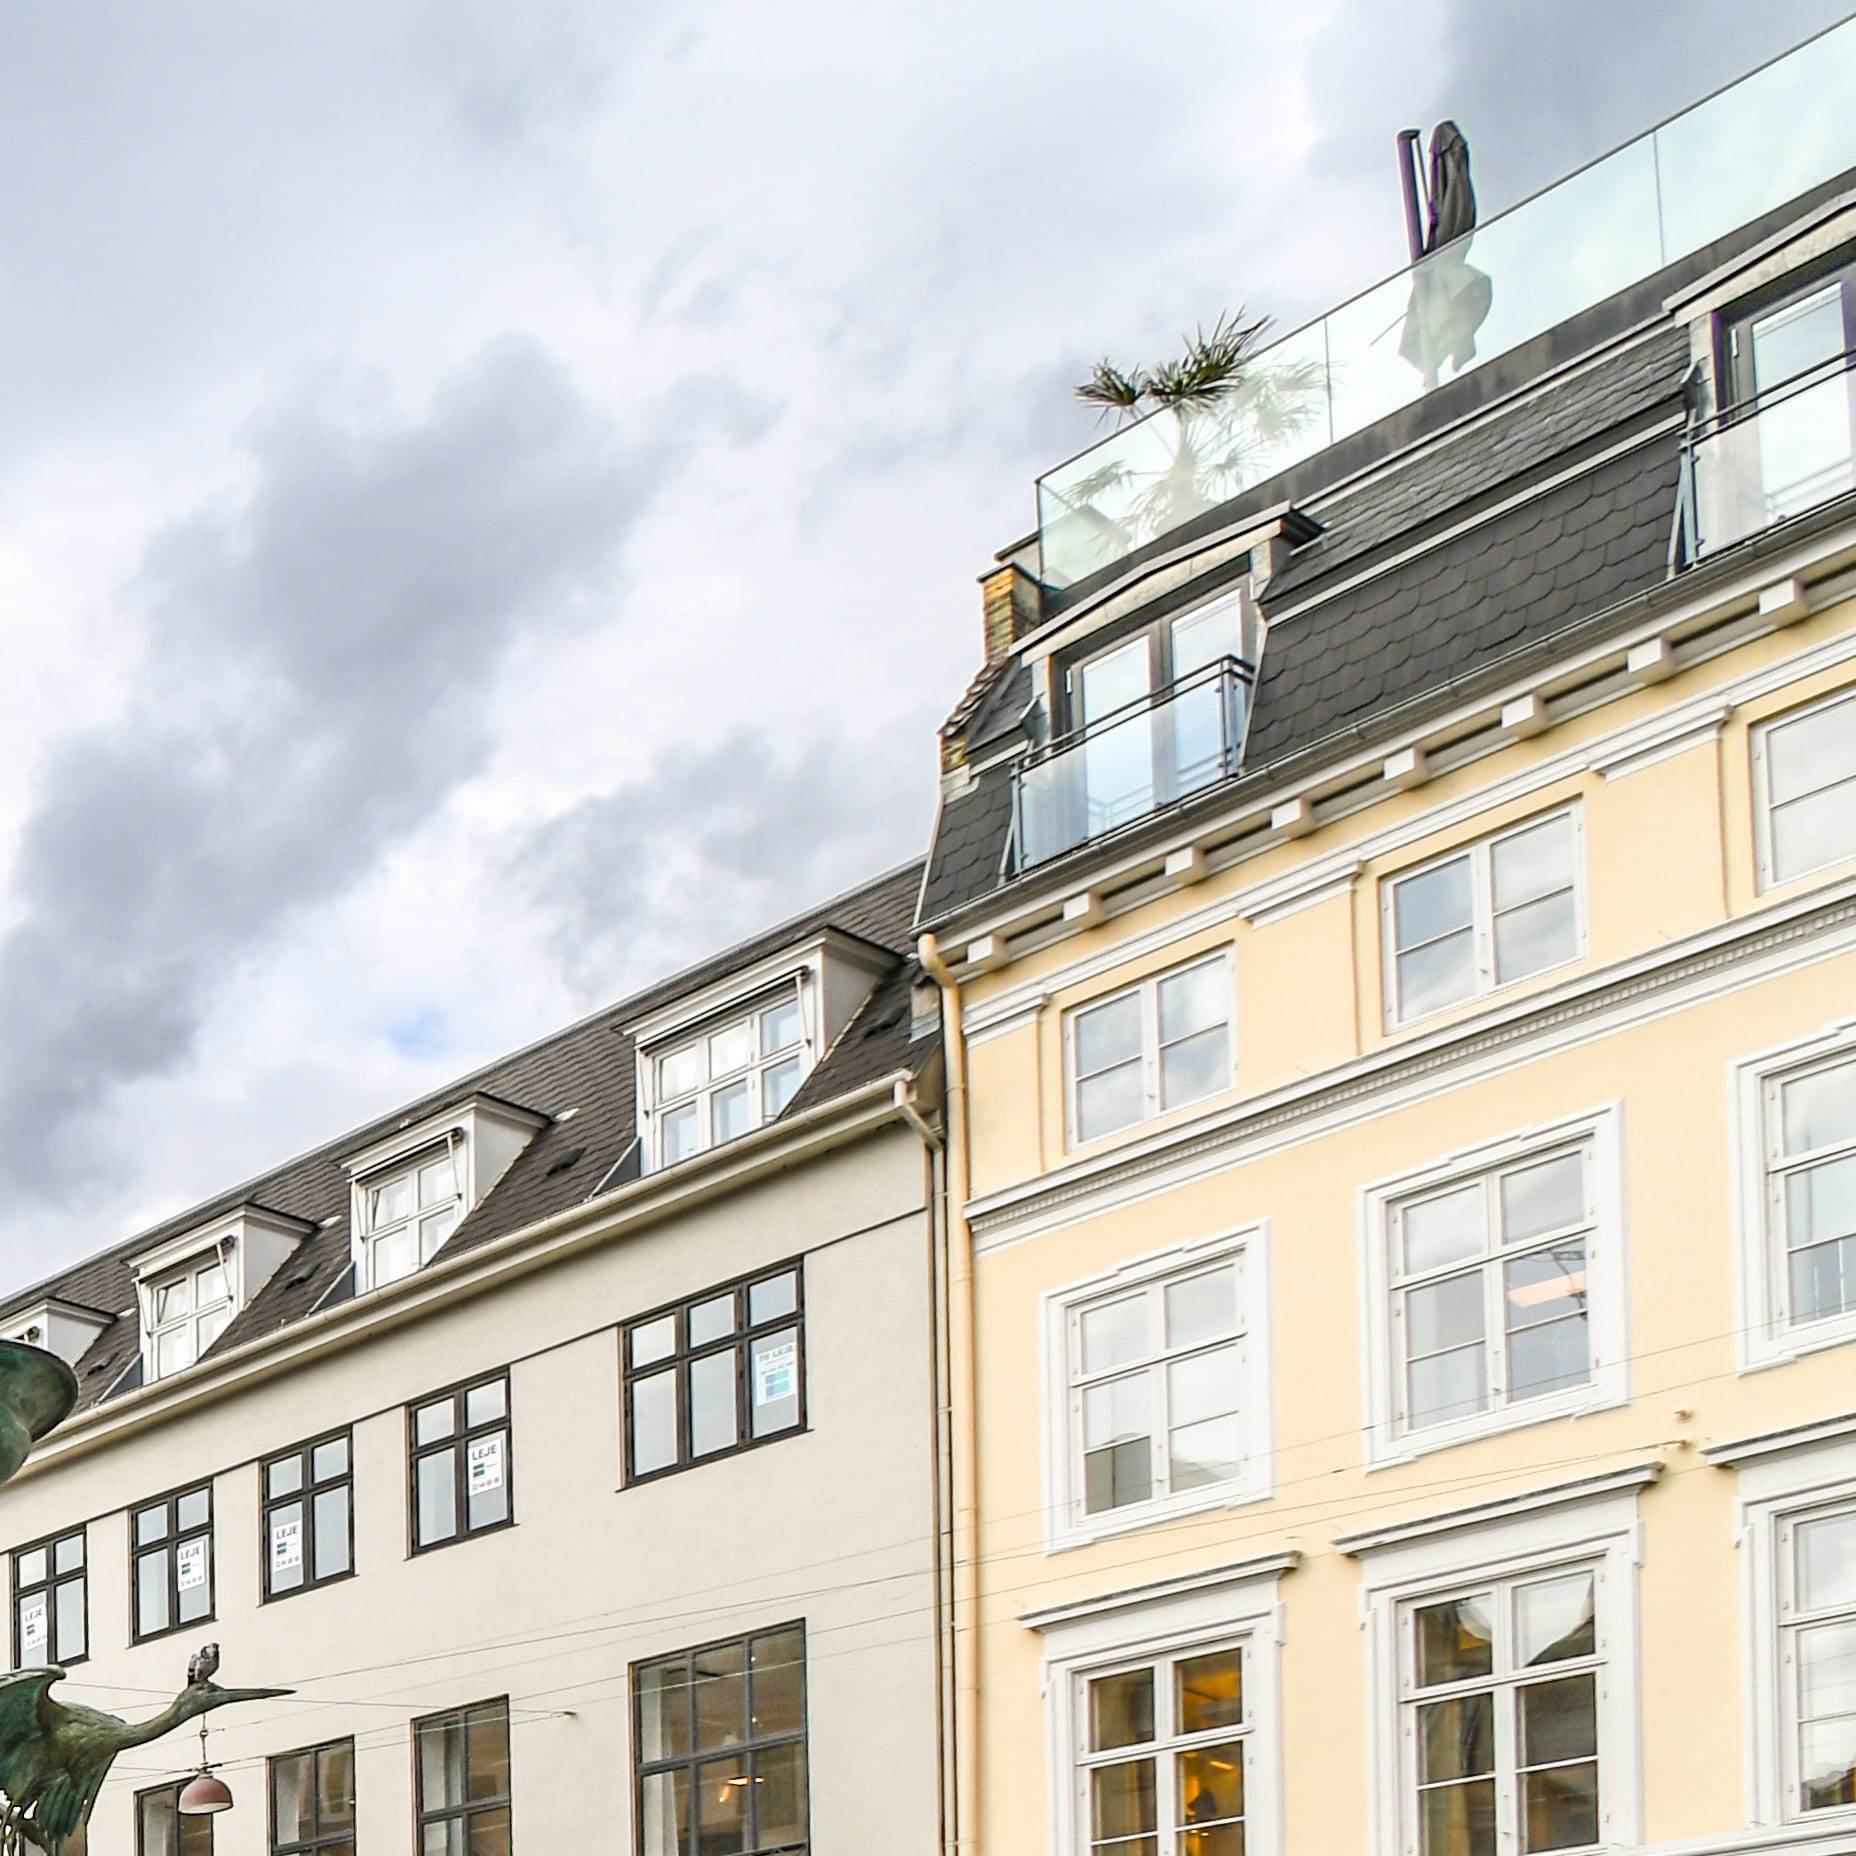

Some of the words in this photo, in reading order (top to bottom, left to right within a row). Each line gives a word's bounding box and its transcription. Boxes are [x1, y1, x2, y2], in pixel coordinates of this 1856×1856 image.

[472, 1444, 497, 1461] LEJE
[276, 1525, 298, 1539] LEJE
[180, 1545, 201, 1560] LEJE
